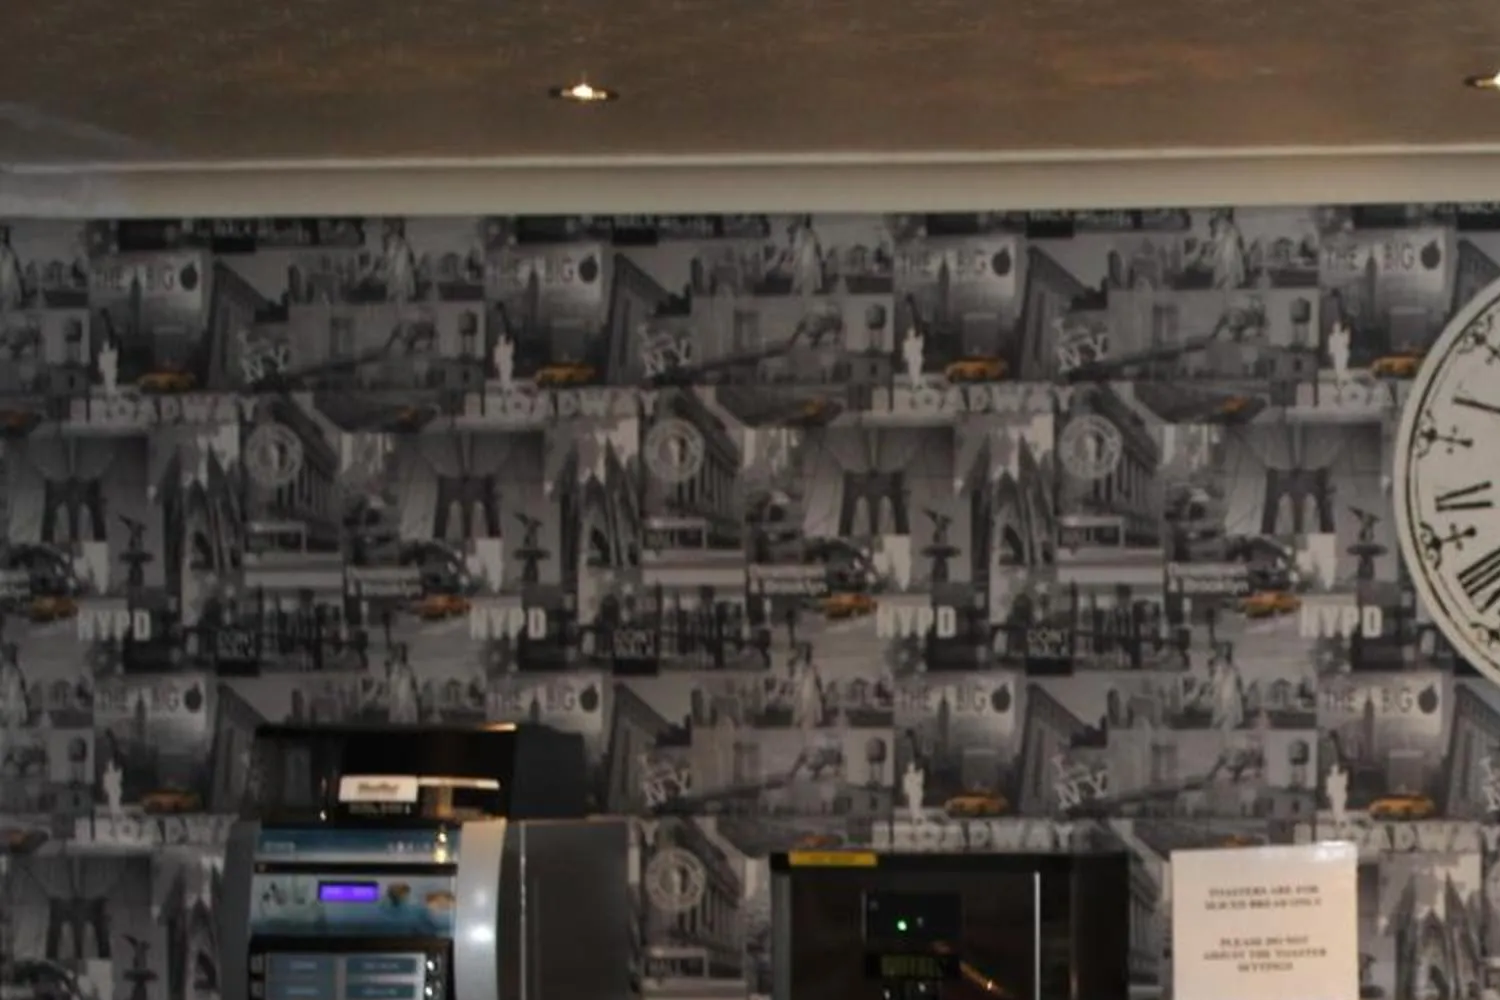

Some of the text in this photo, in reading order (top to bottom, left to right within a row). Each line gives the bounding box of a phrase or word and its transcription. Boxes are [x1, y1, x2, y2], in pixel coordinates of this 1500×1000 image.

[78, 608, 151, 642] NYPD
[470, 607, 547, 641] NYPD
[877, 604, 957, 639] NYPD
[1301, 604, 1382, 639] NYPD
